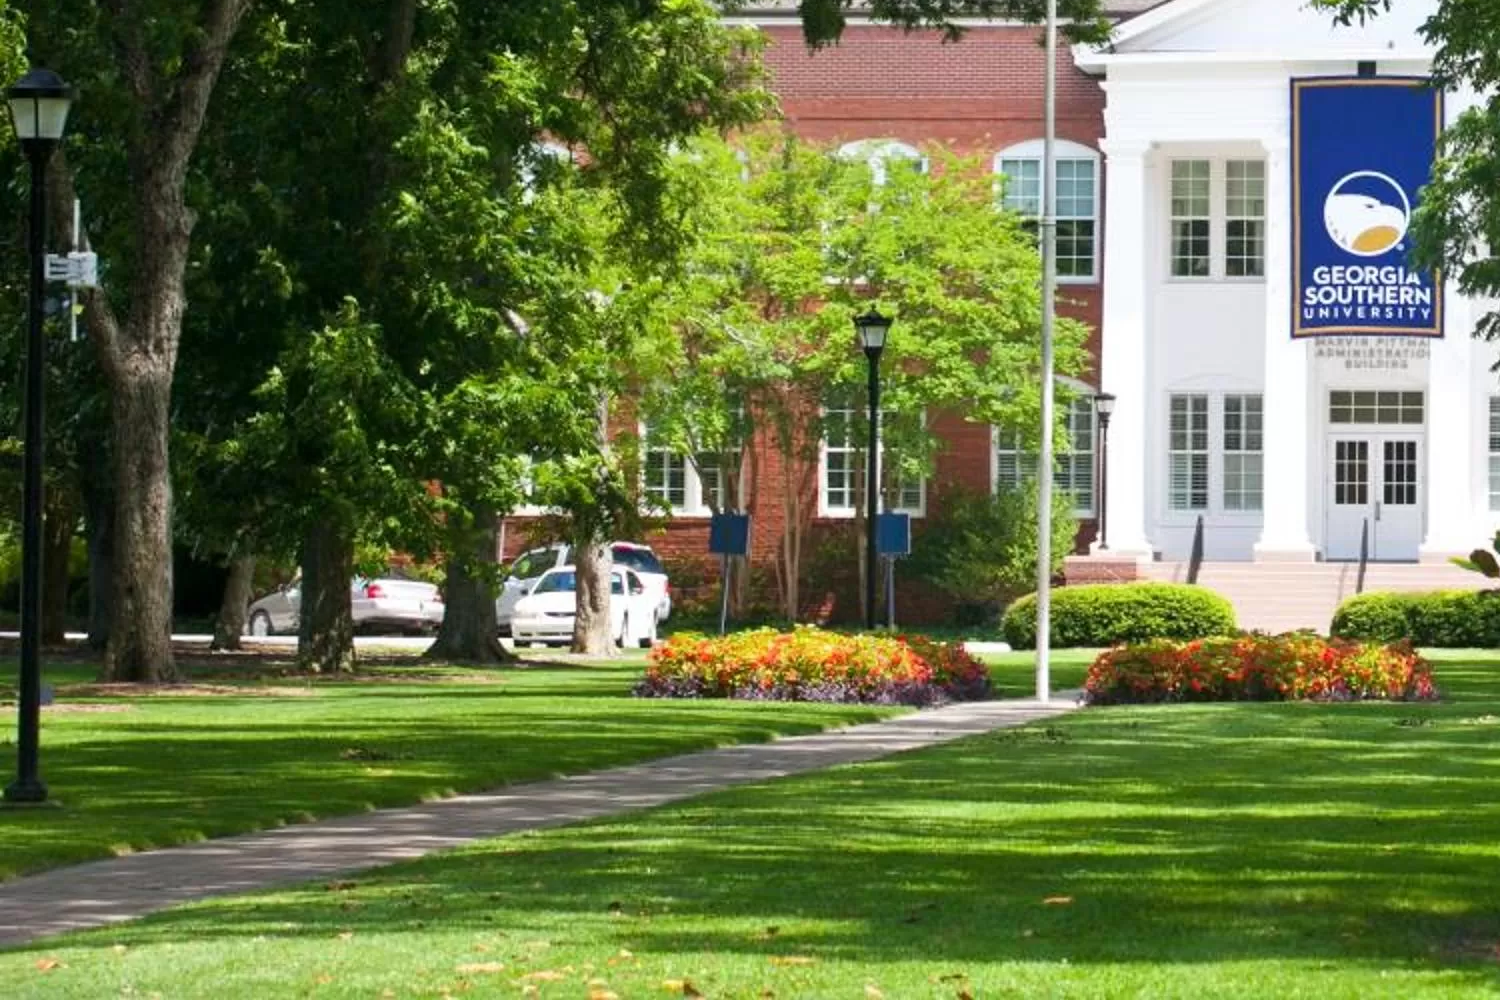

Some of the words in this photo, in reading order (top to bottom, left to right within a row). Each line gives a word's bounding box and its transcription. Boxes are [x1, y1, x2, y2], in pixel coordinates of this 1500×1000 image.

[1313, 265, 1421, 285] GEORGIA
[1304, 285, 1431, 305] SOUTHERN
[1304, 306, 1431, 319] UNIVERSITY
[1377, 337, 1430, 346] PITTMA
